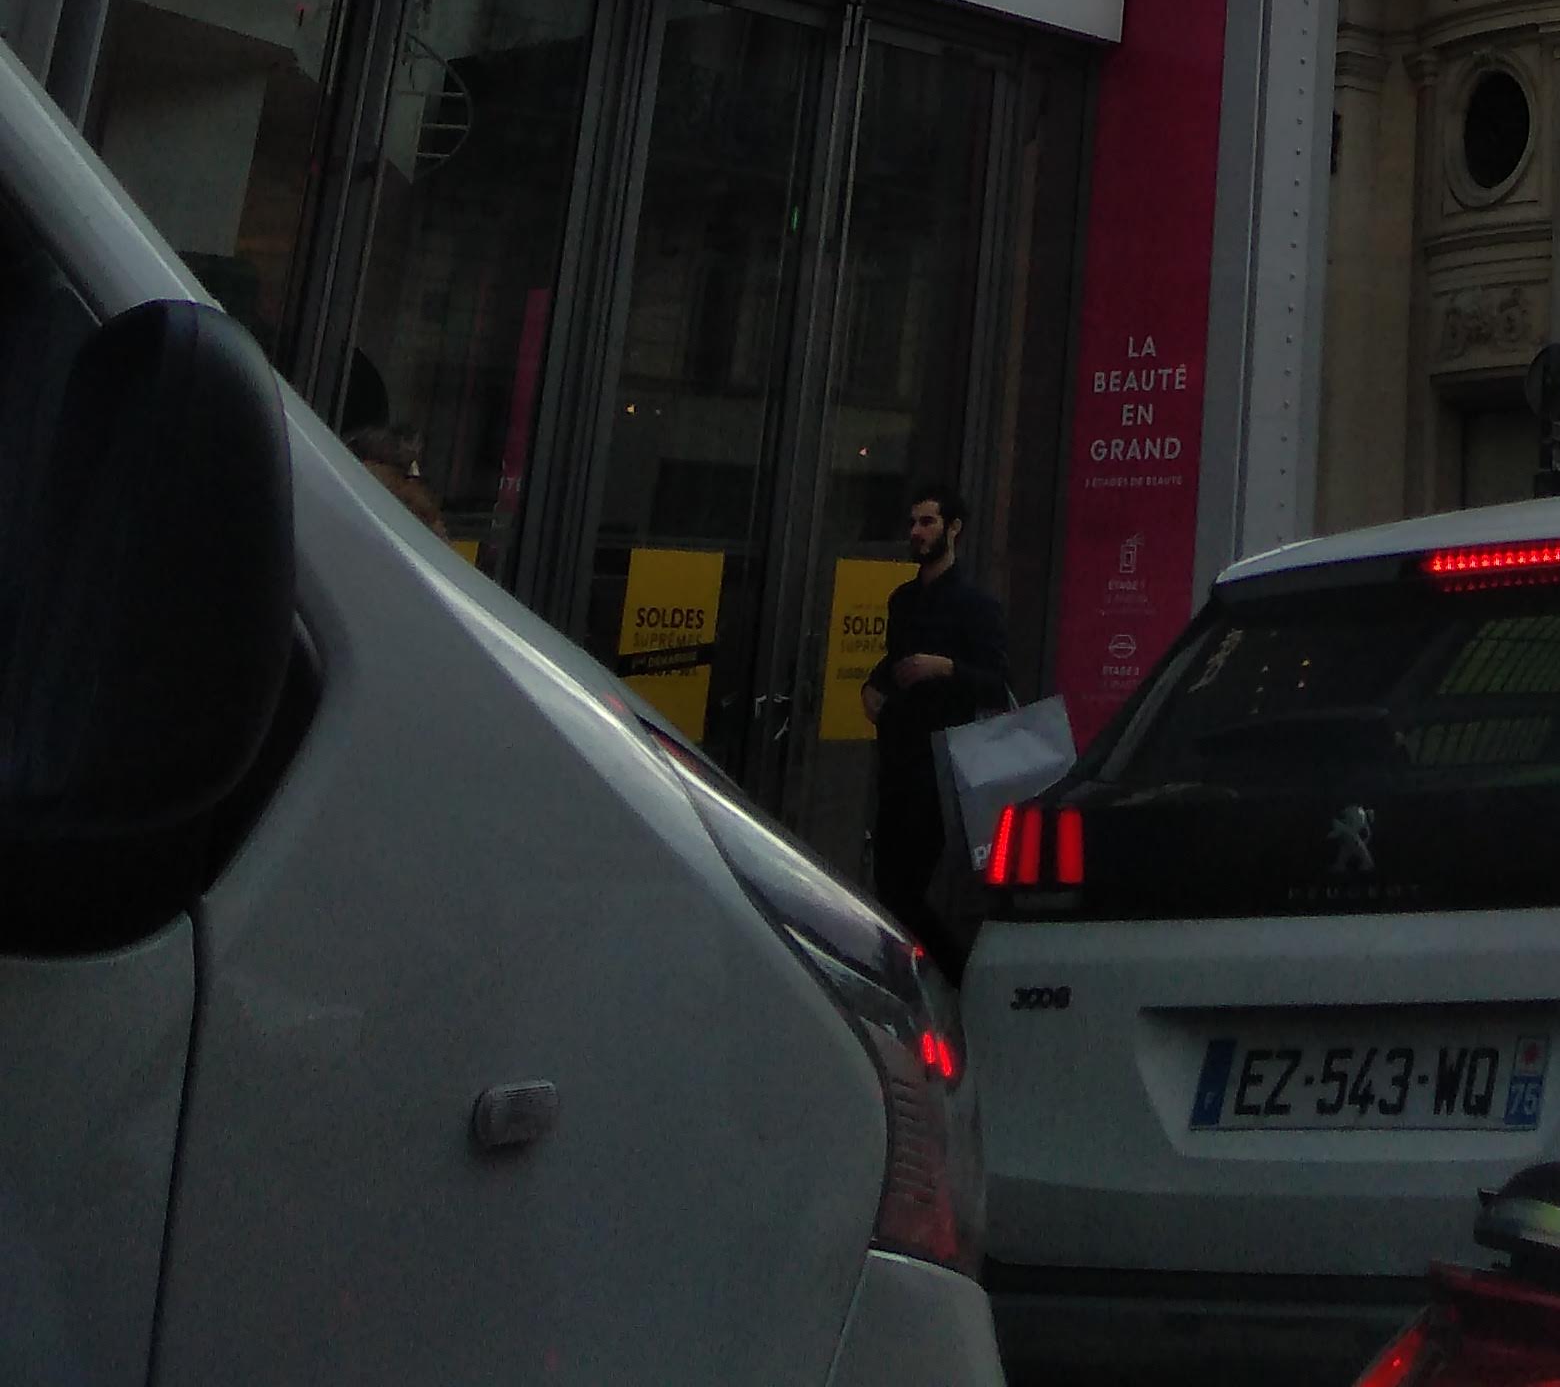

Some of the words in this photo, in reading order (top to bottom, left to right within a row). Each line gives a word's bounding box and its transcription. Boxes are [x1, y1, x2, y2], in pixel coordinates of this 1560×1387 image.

[1127, 334, 1157, 358] LA
[1093, 363, 1187, 393] BEAUTÉ
[1121, 403, 1153, 427] EN
[1090, 437, 1182, 462] GRAND
[635, 606, 705, 630] SOLDES
[1233, 1045, 1501, 1117] EZ-543-WQ
[1508, 1084, 1541, 1116] 75
